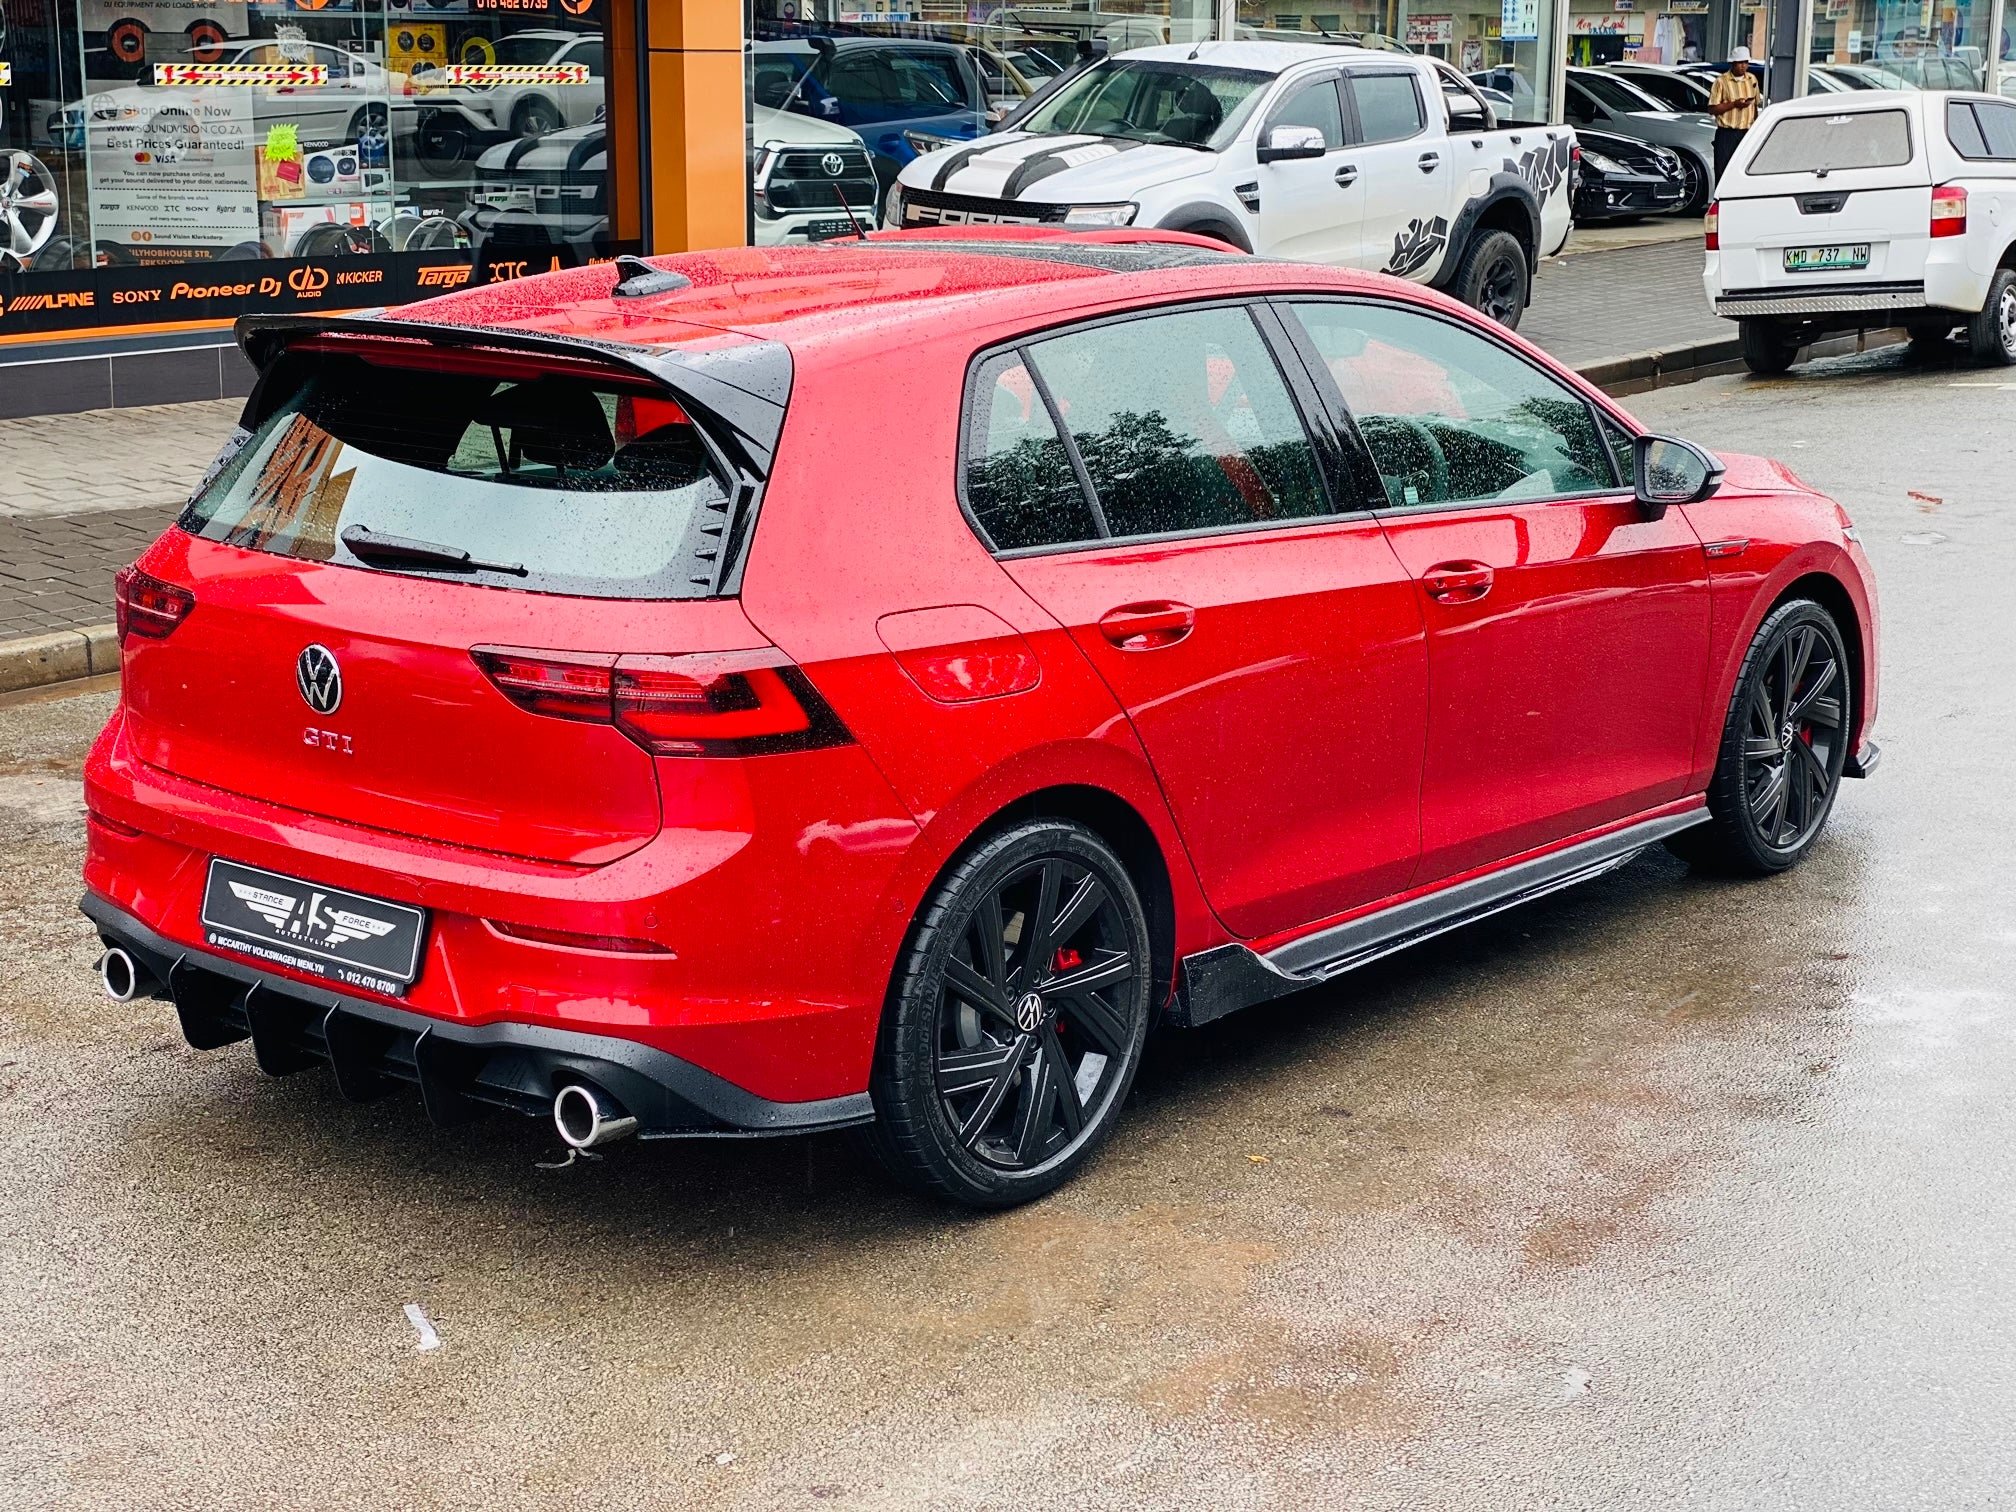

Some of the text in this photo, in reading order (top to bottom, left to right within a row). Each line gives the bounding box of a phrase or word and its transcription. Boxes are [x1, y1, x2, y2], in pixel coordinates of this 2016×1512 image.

[124, 105, 231, 118] Shop Online Now
[107, 138, 244, 150] Best Prices Guaranteed!
[216, 205, 236, 214] Hybrid
[1786, 247, 1868, 264] KMD 737 NW
[8, 292, 95, 311] ALPINE
[112, 289, 162, 304] SONY
[170, 282, 255, 300] Pioneer
[345, 270, 383, 284] KICKER
[417, 264, 473, 288] Targa
[302, 727, 354, 755] GTI
[253, 891, 284, 906] STANCE
[342, 914, 371, 929] FORCE
[275, 929, 336, 949] AUTOSTYLING
[217, 935, 396, 994] MCCARTHY VOLKSWAGEN MENLYN 012 470 8700
